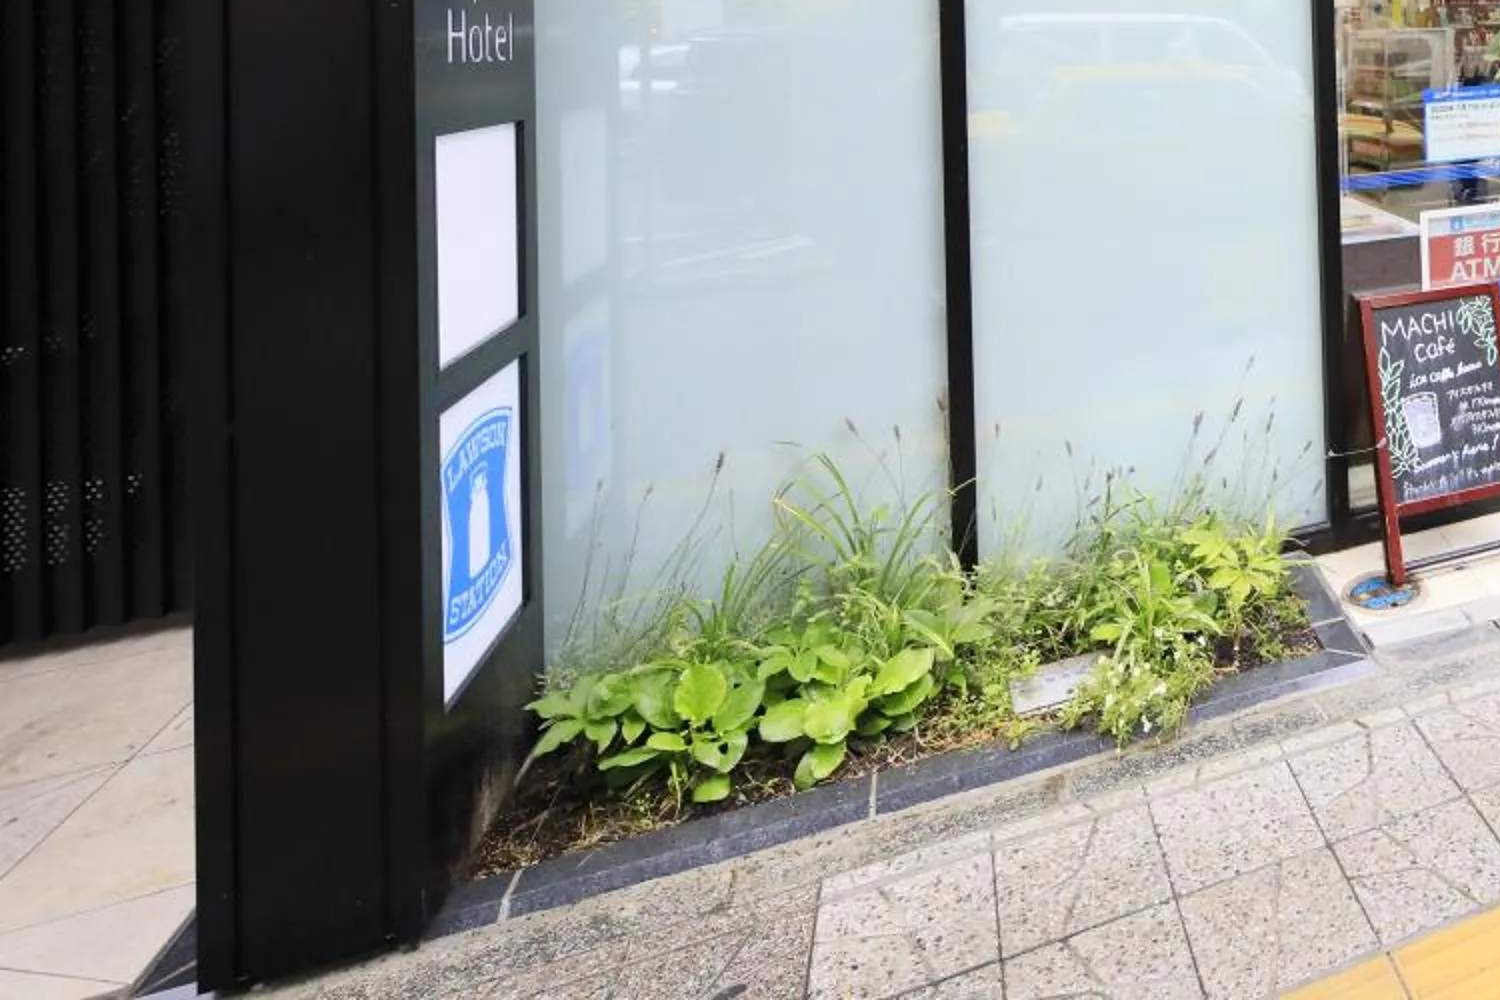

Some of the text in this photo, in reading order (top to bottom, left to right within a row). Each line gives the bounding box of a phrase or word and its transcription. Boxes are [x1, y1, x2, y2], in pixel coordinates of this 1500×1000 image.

[447, 7, 514, 64] Hotel
[1381, 310, 1455, 347] MACHI
[448, 420, 508, 489] LAWSON
[449, 541, 509, 625] STATION
